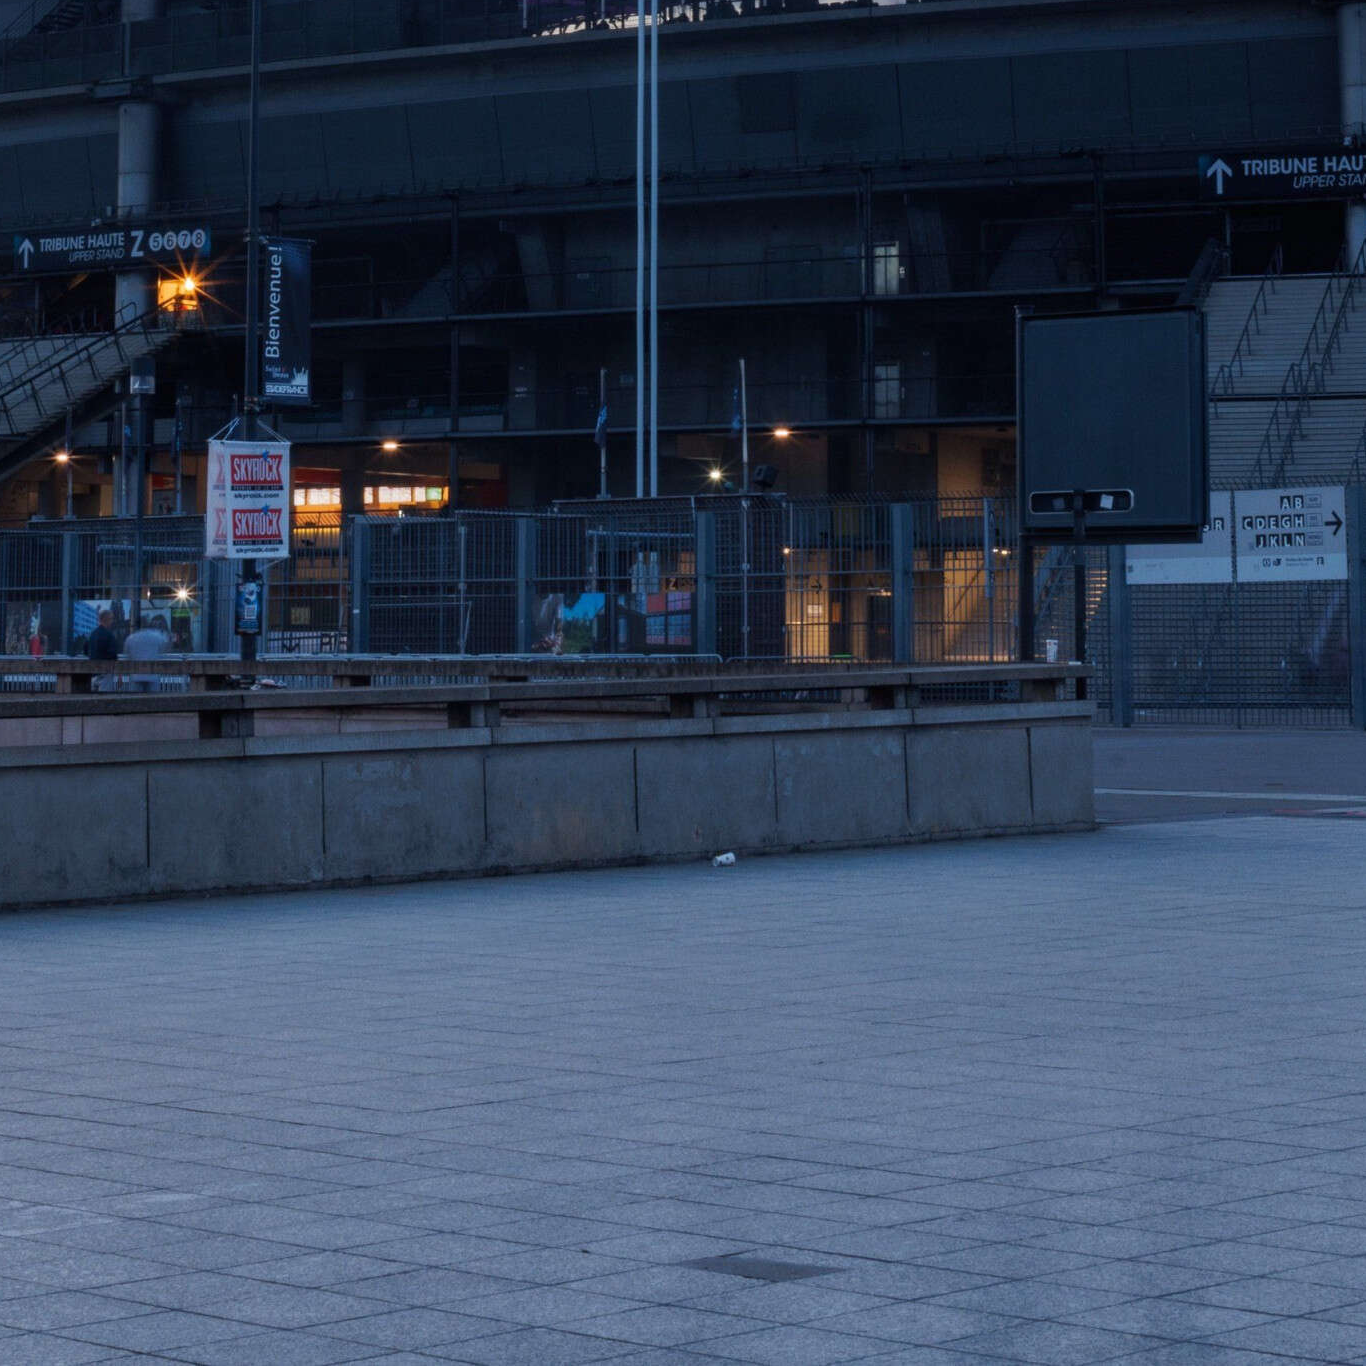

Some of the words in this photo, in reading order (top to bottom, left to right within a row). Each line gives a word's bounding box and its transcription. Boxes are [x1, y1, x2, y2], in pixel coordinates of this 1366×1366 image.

[1241, 156, 1317, 177] TRIBUNE
[1293, 174, 1335, 189] UPPER
[39, 236, 85, 252] TRIBUNE
[88, 232, 125, 248] HAUTE
[131, 230, 144, 257] Z
[68, 249, 95, 263] UPPER
[96, 247, 125, 259] STAND
[265, 245, 282, 358] Bienvenue!
[233, 457, 280, 482] SKYROCK
[234, 511, 280, 536] SKYROCK
